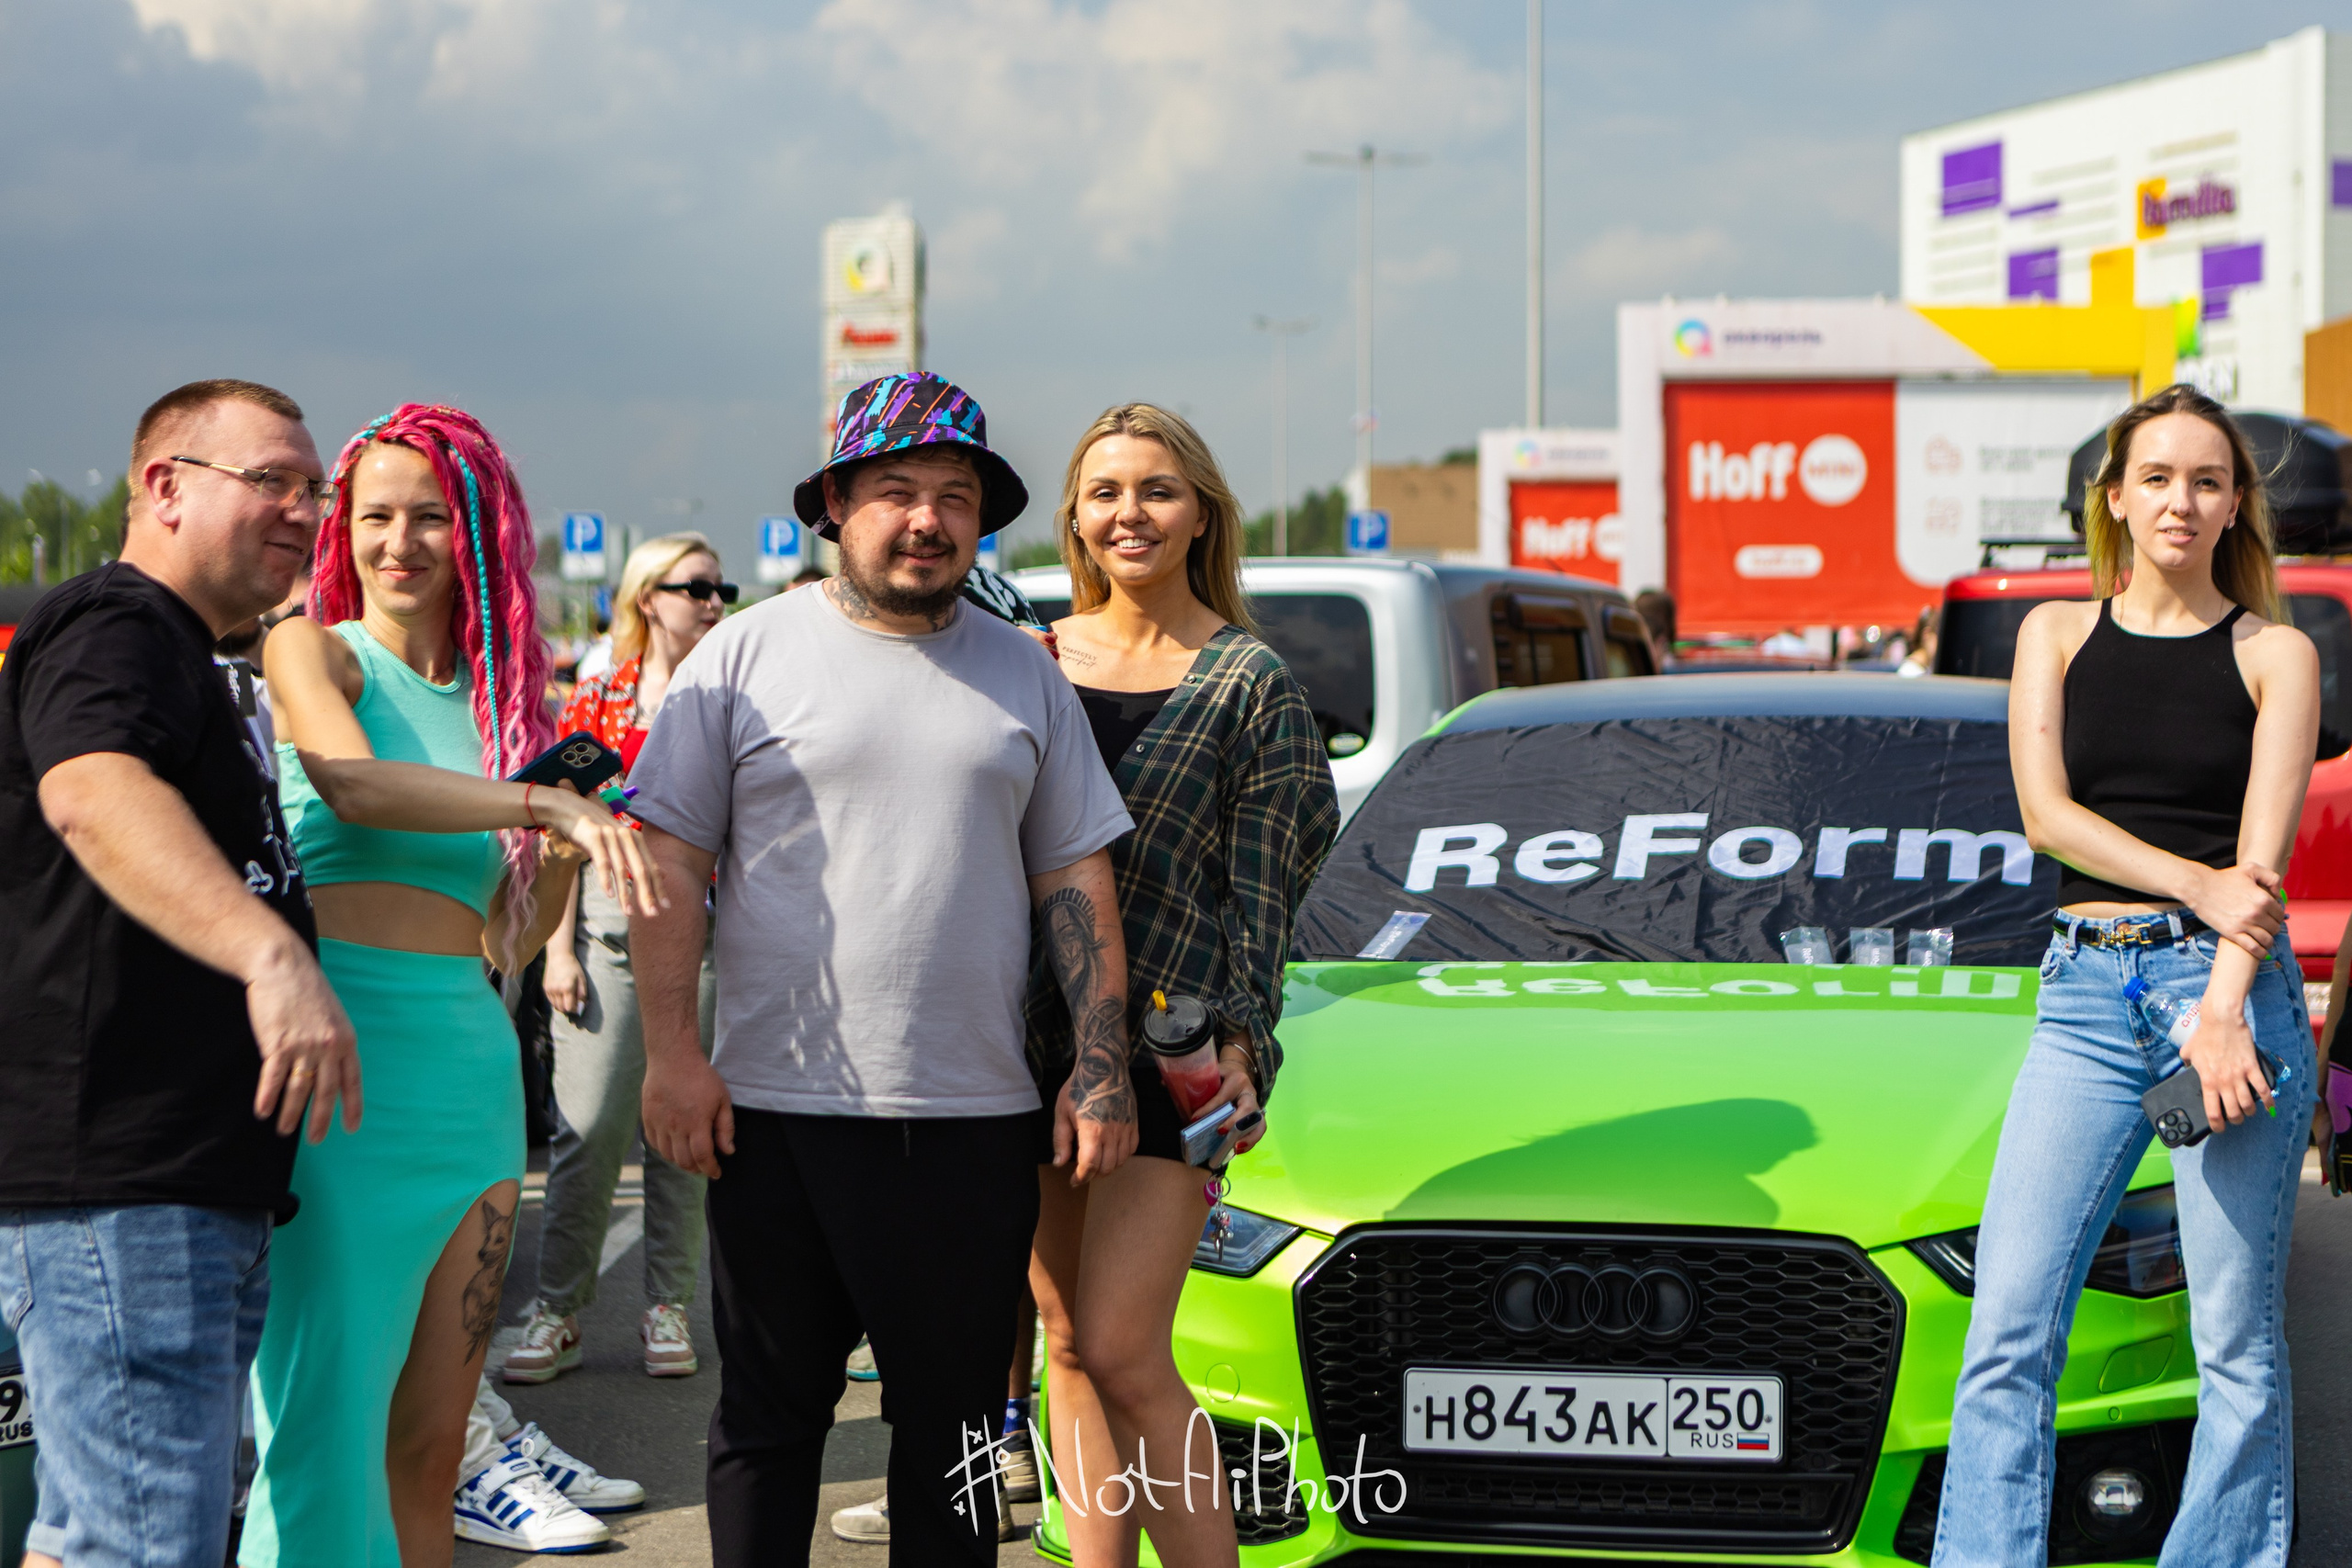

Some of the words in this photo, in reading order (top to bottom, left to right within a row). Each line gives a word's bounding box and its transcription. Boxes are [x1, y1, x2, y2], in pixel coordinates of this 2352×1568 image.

[1689, 440, 1797, 502] Hoff
[1403, 812, 2034, 893] ReForm
[1672, 1387, 1765, 1432] 250
[1690, 1430, 1735, 1450] RUS
